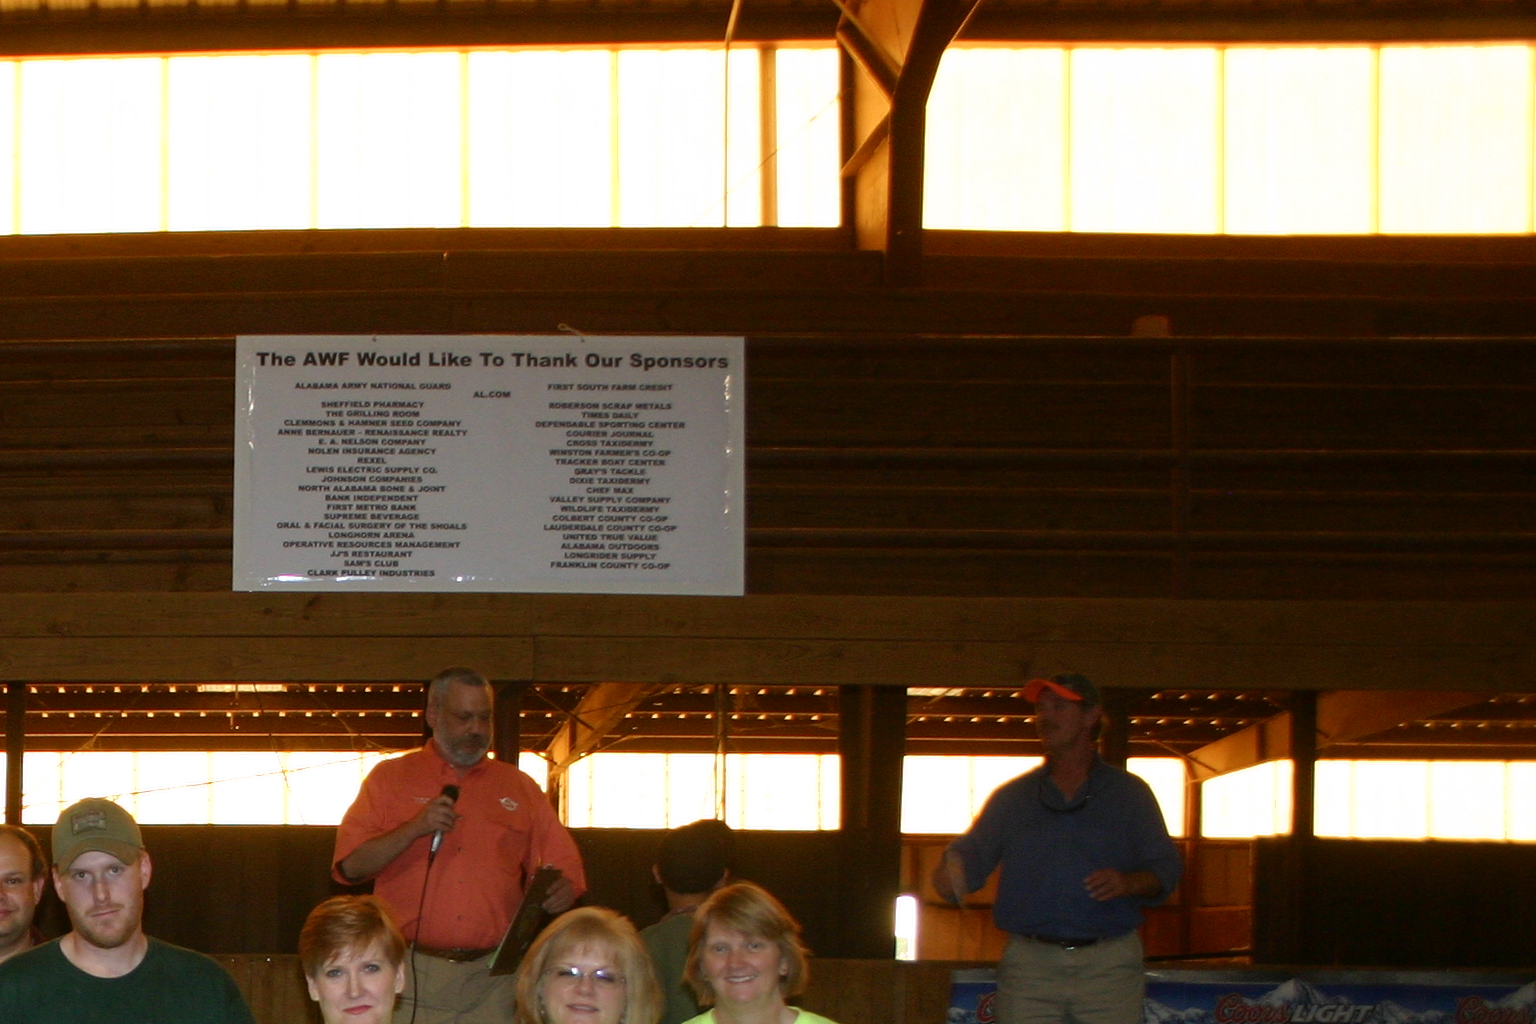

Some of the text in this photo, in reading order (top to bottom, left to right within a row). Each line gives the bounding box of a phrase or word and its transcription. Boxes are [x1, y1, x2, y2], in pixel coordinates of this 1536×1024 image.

[257, 352, 729, 371] The AWF Would Like To Thank Our Sponsors
[342, 382, 368, 390] ARMY
[370, 382, 416, 390] NATIONAL
[548, 383, 574, 391] FIRST
[576, 383, 609, 391] SOUTH
[602, 402, 633, 410] SCRAP
[392, 410, 420, 418] ROOM
[582, 411, 610, 419] TIMES
[339, 419, 345, 427] &
[598, 421, 646, 429] SPORTING
[648, 421, 686, 429] CENTER
[278, 428, 303, 436] ANNE
[432, 429, 468, 437] REALTY
[566, 430, 654, 438] COURIER JOURNAL
[381, 438, 426, 446] COMPANY
[342, 447, 396, 455] INSURANCE
[594, 449, 640, 457] FARMER'S
[642, 449, 671, 457] CO-OP
[556, 458, 599, 466] TRACKER
[337, 466, 382, 474] ELECTRIC
[384, 466, 420, 474] SUPPLY
[322, 475, 366, 483] JOHNSON
[569, 477, 650, 485] DIXIE TAXIDERMY
[380, 485, 406, 493] BONE
[408, 485, 414, 493] &
[418, 485, 446, 493] JOINT
[586, 486, 610, 494] CHEF
[325, 494, 418, 502] BANK INDEPENDENT
[625, 496, 671, 504] COMPANY
[560, 505, 604, 513] WILDLIFE
[639, 515, 668, 523] CO-OP
[348, 522, 392, 530] SURGERY
[394, 522, 406, 530] OF
[544, 524, 604, 532] LAUDERDALE
[606, 524, 646, 532] COUNTY
[328, 531, 380, 539] LONGHORN
[562, 533, 598, 541] UNITED
[283, 540, 334, 548] OPERATIVE
[395, 541, 460, 549] MANAGEMENT
[351, 550, 412, 558] RESTAURANT
[620, 552, 656, 560] SUPPLY
[550, 561, 598, 569] FRANKLIN
[341, 569, 376, 577] PULLEY
[379, 569, 435, 577] INDUSTRIES
[1291, 1004, 1372, 1024] LIGHT
